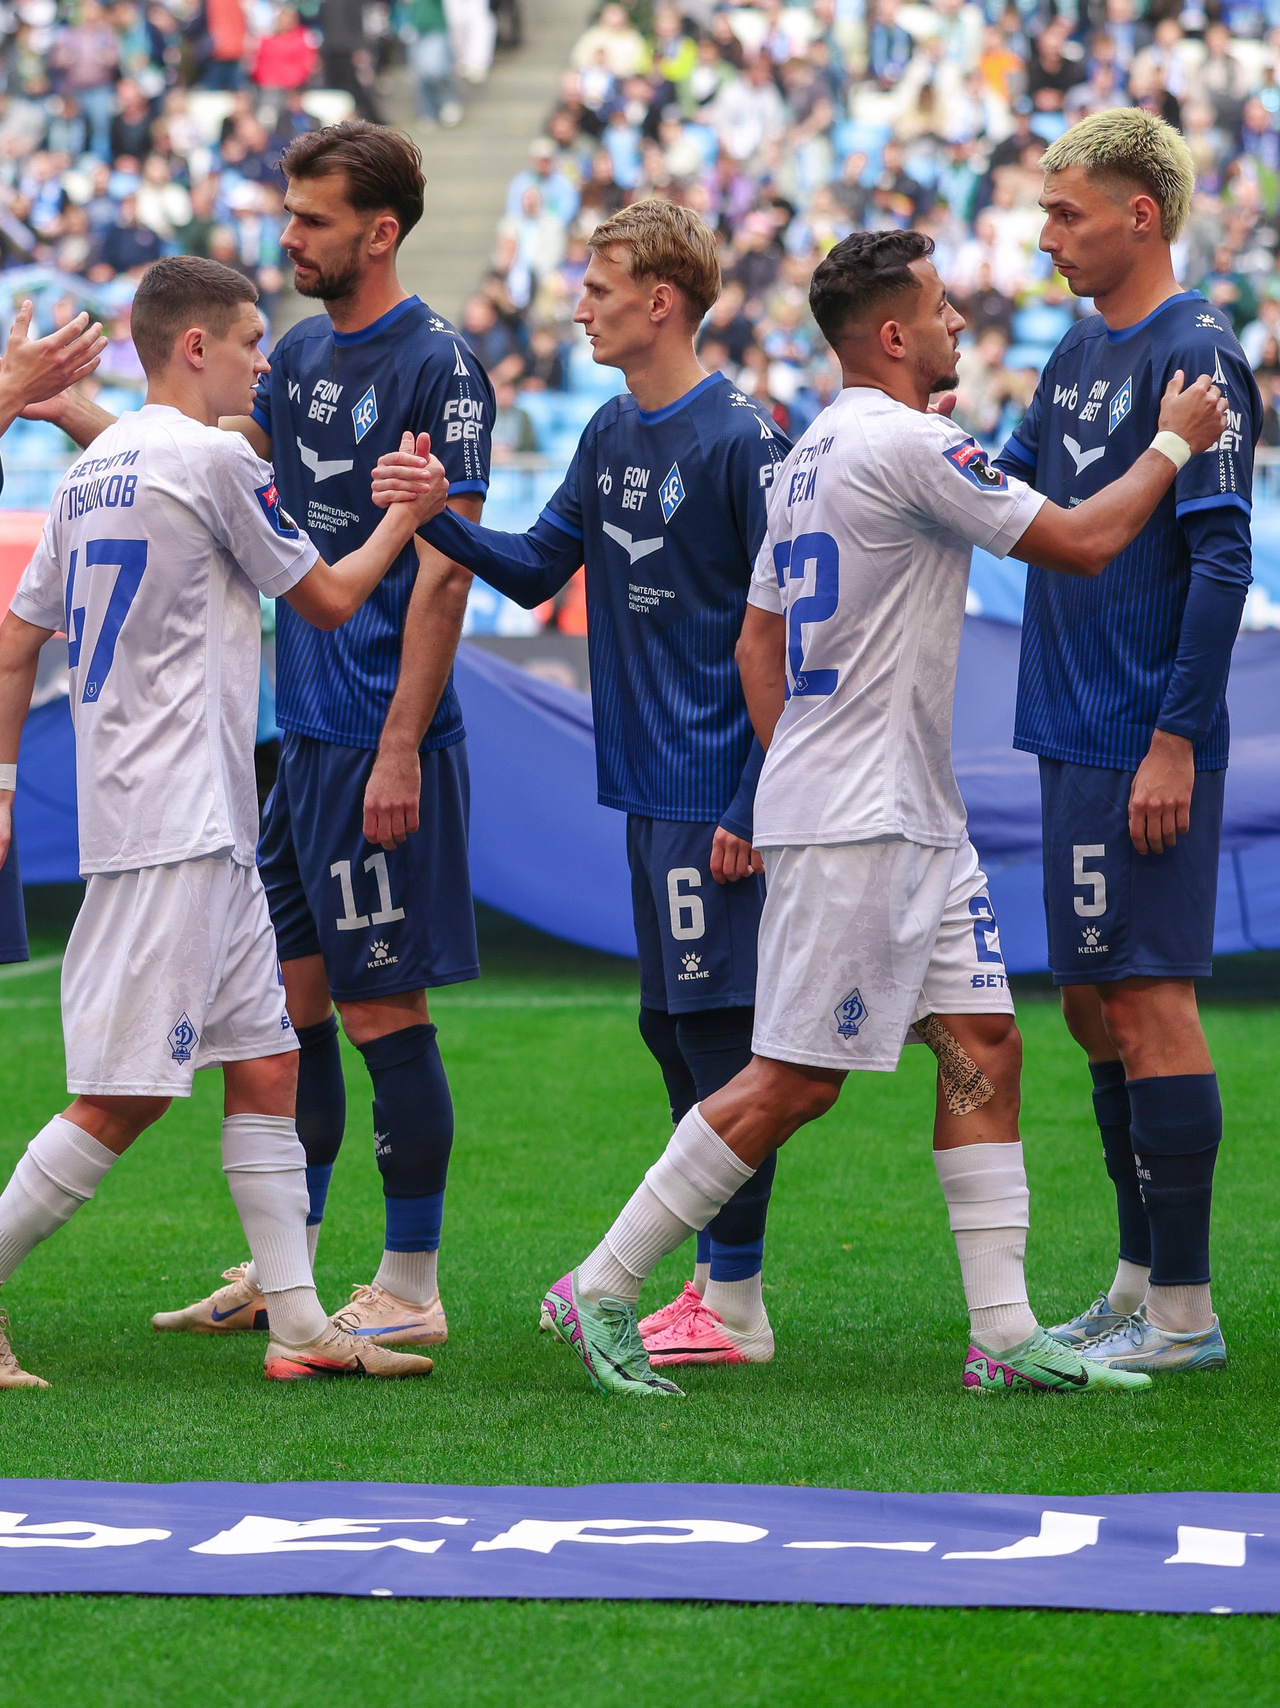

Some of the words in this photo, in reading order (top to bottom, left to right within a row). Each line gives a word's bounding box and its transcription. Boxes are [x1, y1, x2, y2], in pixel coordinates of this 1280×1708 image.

[311, 379, 344, 404] FON
[307, 399, 338, 425] BET
[443, 398, 484, 420] FON
[1078, 401, 1103, 422] BET
[445, 420, 484, 443] BET
[623, 466, 651, 489] FON
[621, 488, 648, 511] BET
[330, 852, 406, 931] 11
[1073, 843, 1107, 917] 5
[667, 867, 706, 941] 6
[1078, 945, 1109, 954] KELME
[367, 955, 399, 969] KELME
[677, 970, 710, 981] KELME
